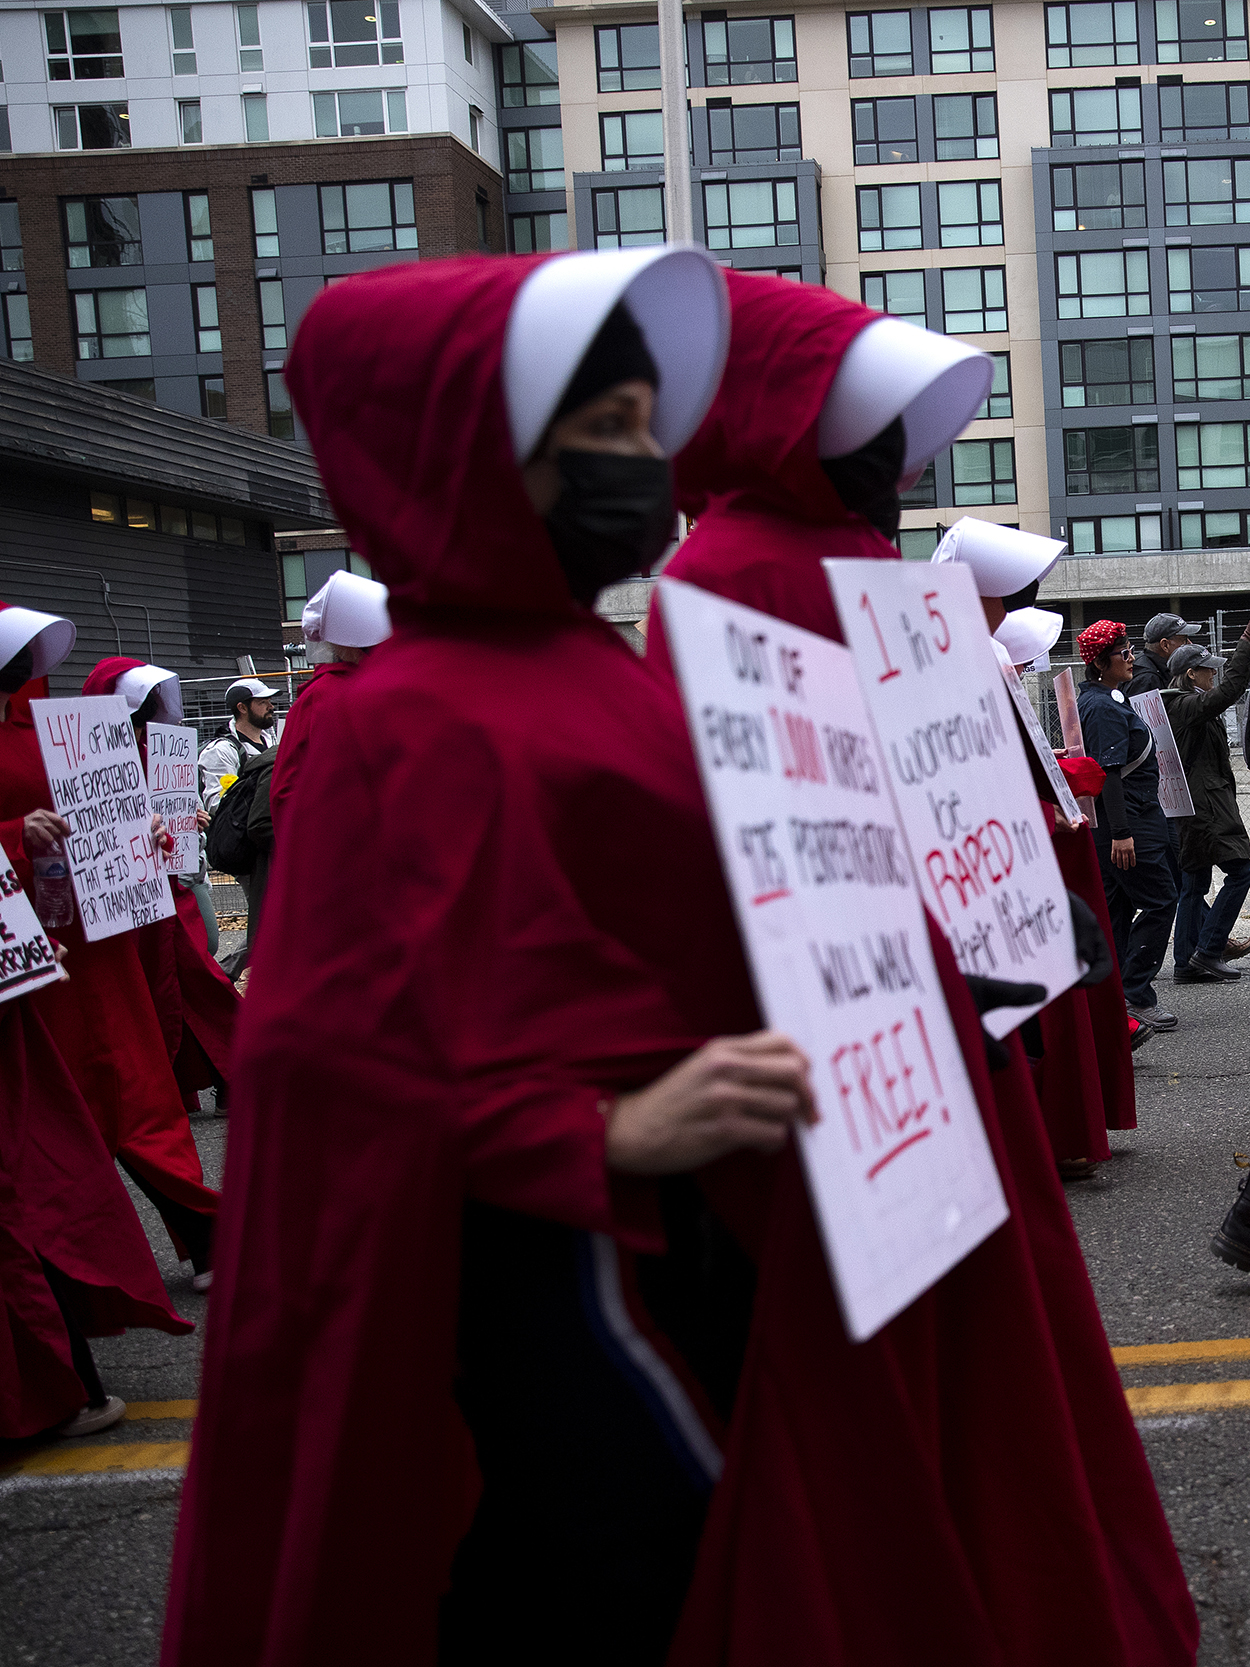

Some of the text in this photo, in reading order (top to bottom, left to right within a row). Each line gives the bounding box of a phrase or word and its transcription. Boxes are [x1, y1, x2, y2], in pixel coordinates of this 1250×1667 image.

[860, 590, 950, 684] 1 in 5
[46, 712, 136, 770] 41% OF WOMEN
[150, 733, 189, 760] IN 2025
[52, 760, 140, 808] HAVE EXPERIENCED
[153, 763, 195, 791] 10 STATES
[61, 792, 152, 835] INTIMATE PARTNER
[151, 799, 165, 815] HAVE
[164, 796, 187, 815] ABORTION
[926, 789, 972, 842] be
[66, 826, 123, 865] VIOLENCE.
[182, 836, 190, 851] OR
[74, 865, 102, 893] THAT
[925, 819, 1040, 924] RAPED in
[81, 897, 102, 927] FOR
[131, 903, 165, 928] PEOPLE.
[0, 934, 55, 980] RRIAGE
[808, 929, 926, 1006] WILL WALK
[830, 1004, 950, 1156] FREE!
